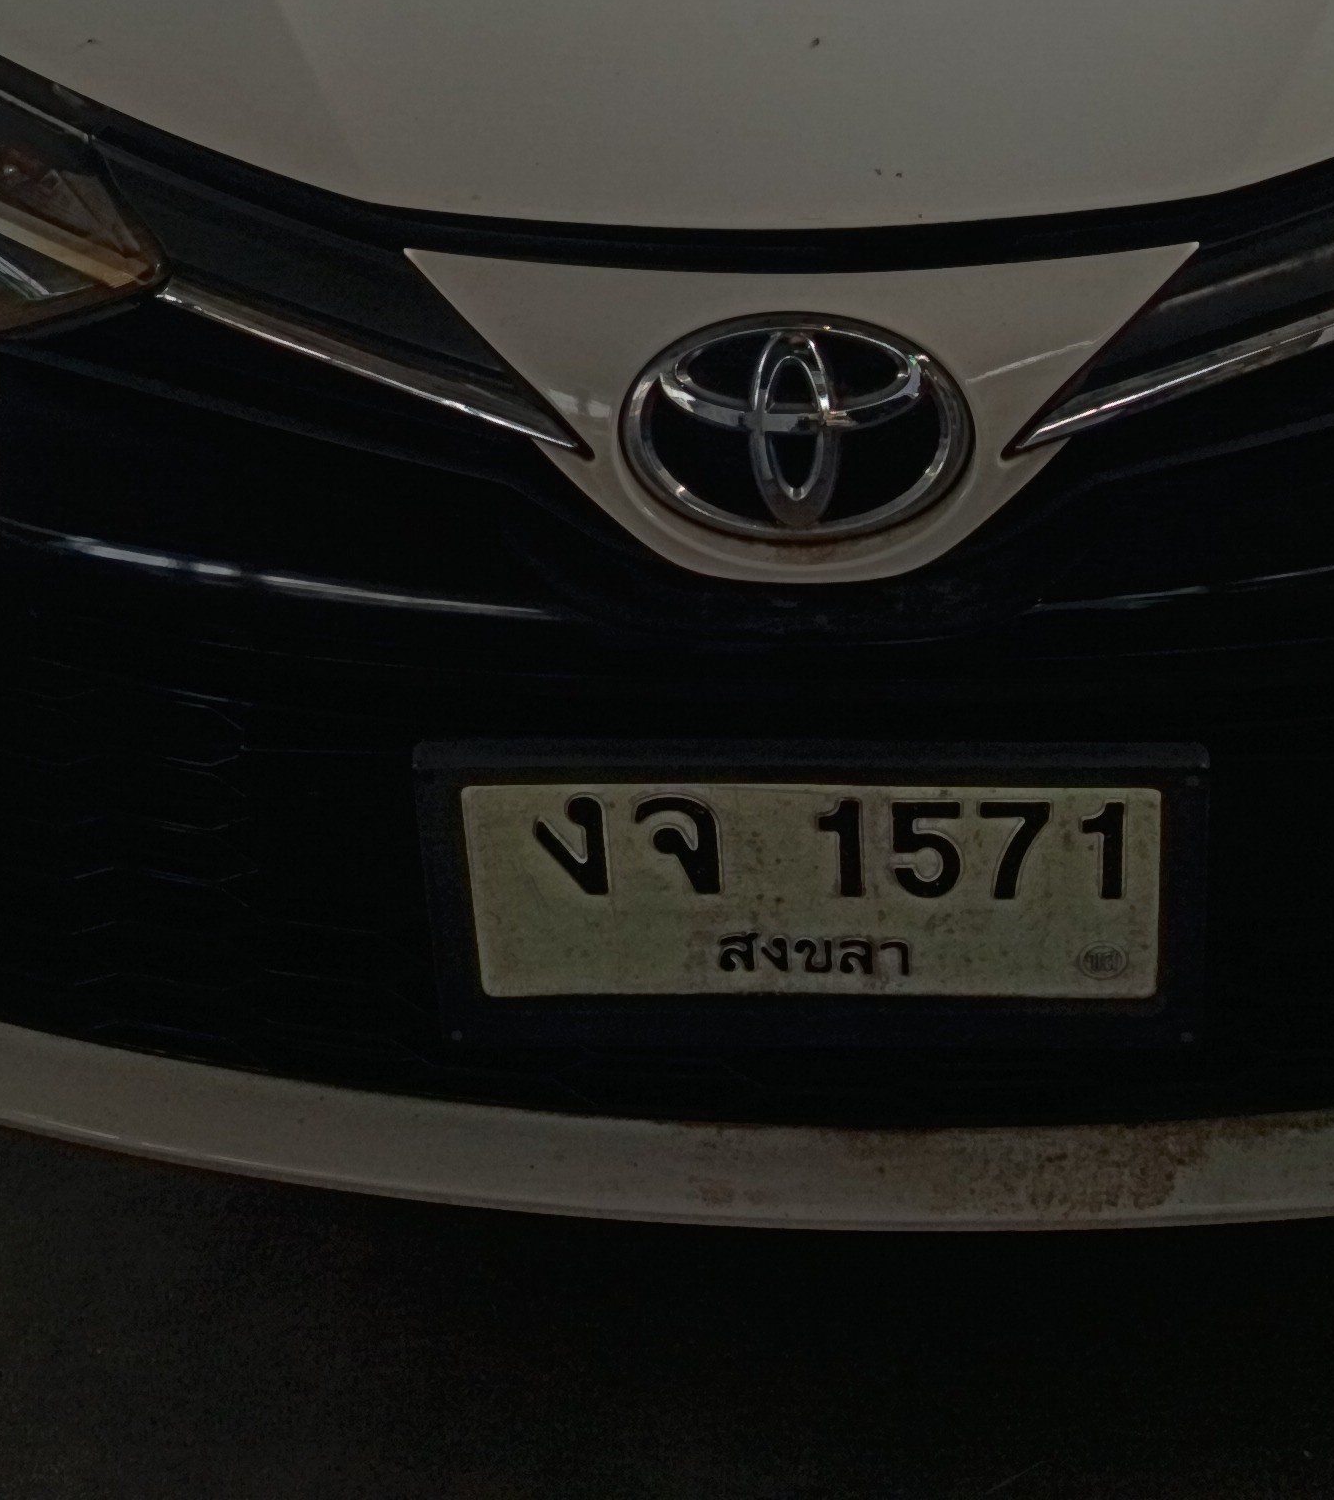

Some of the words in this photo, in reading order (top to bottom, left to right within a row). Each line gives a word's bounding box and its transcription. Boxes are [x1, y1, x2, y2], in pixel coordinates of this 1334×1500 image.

[534, 795, 722, 896] งจ
[817, 797, 1127, 900] 1571
[719, 931, 911, 976] สงขลา
